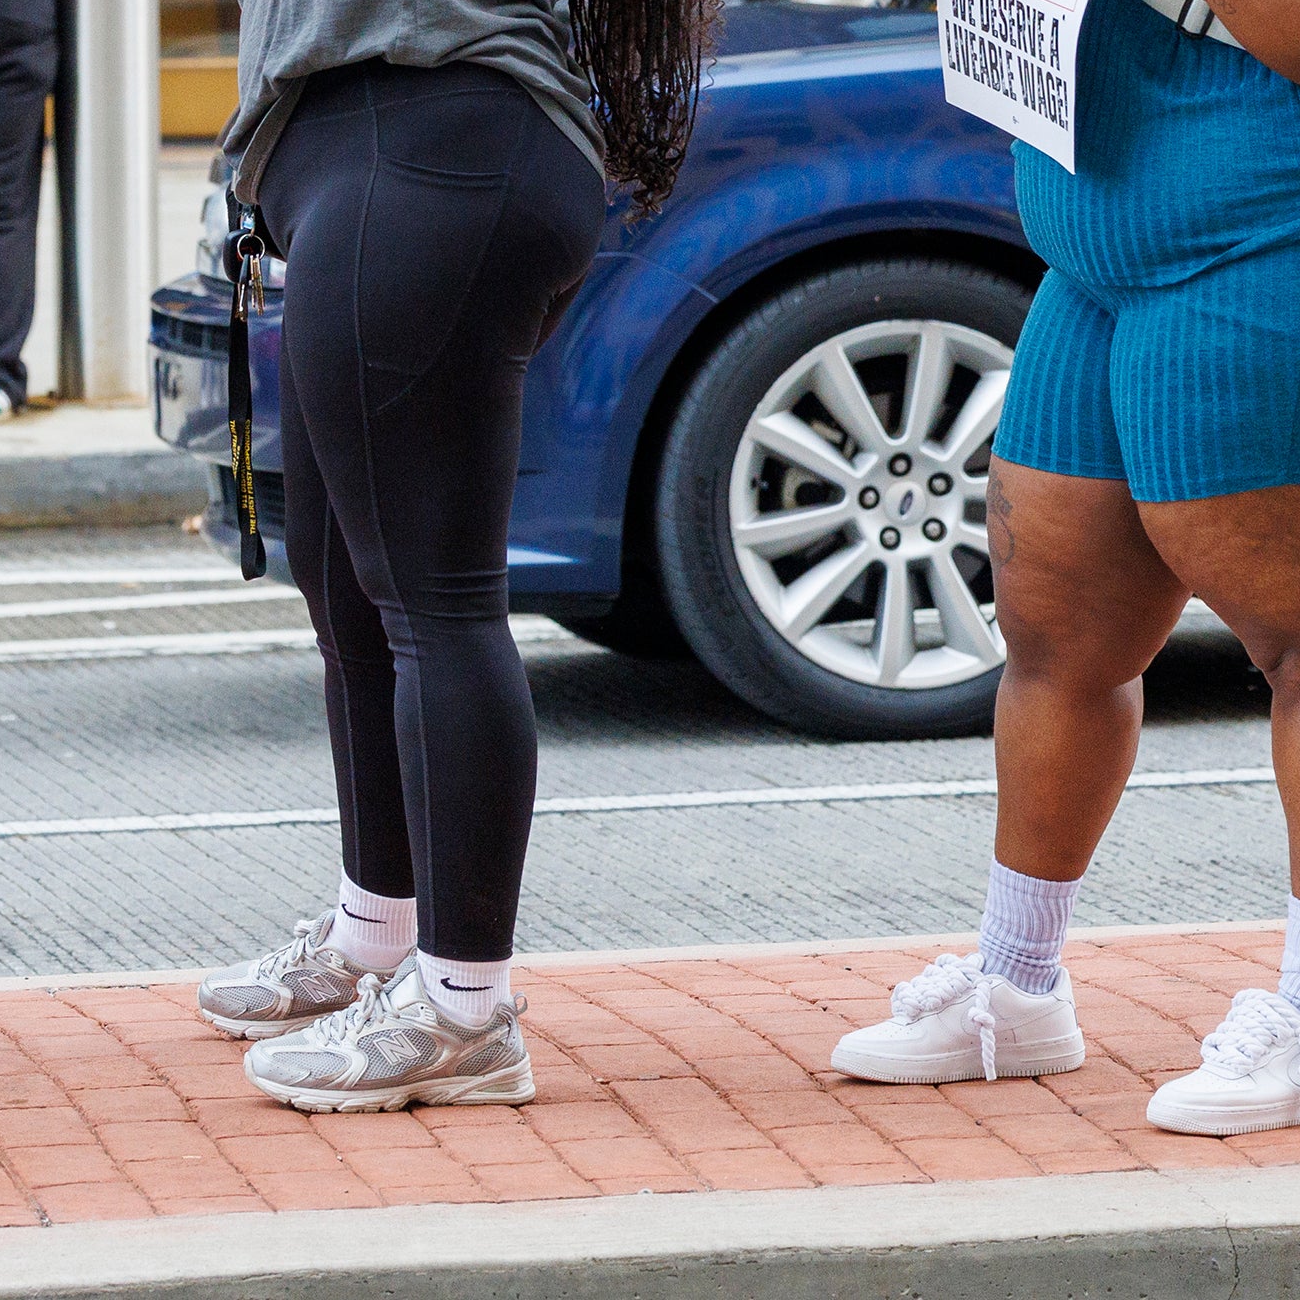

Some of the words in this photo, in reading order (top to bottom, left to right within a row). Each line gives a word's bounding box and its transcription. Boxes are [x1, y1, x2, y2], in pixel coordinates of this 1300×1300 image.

[1050, 16, 1061, 71] A
[944, 19, 1018, 102] LIVEABLE
[1017, 55, 1069, 132] WAGE!
[246, 471, 254, 495] FIRST
[248, 496, 256, 518] FIRST
[249, 519, 257, 535] THE
